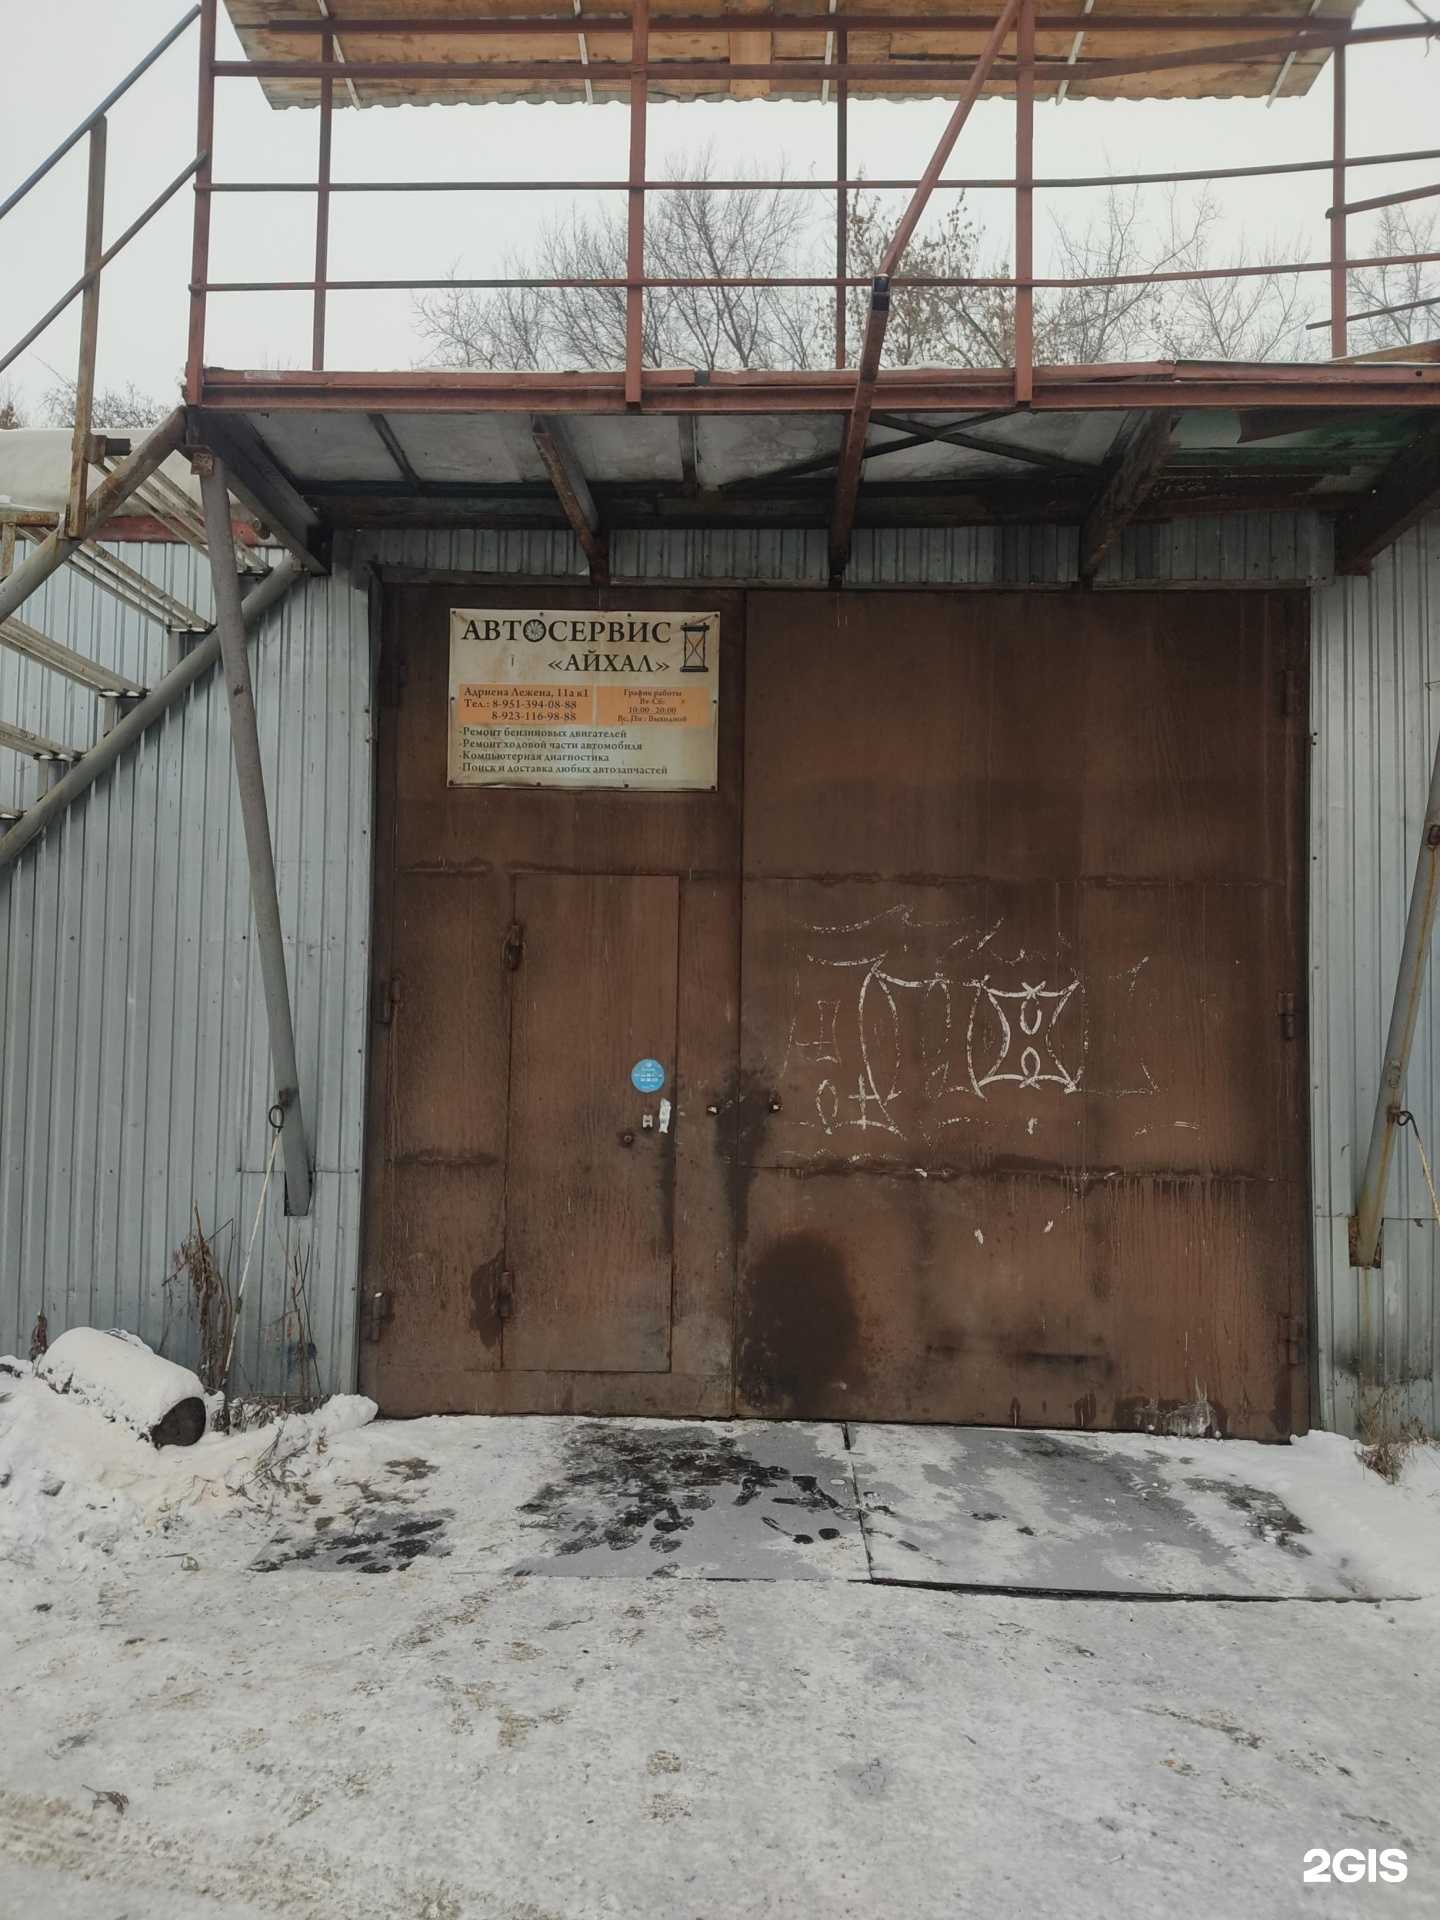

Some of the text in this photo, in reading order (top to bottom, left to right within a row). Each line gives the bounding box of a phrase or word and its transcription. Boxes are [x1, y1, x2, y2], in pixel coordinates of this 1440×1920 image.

[461, 619, 671, 643] АВТОСЕРВИС
[464, 687, 509, 698] Адриена
[492, 700, 577, 709] 8-951-394-08-88
[491, 711, 577, 721] 8-923-116-98-88
[504, 728, 567, 737] бензиновых
[569, 730, 627, 738] двигателей
[503, 740, 546, 750] ходовой
[549, 742, 578, 750] части
[507, 765, 553, 773] доставка
[555, 764, 592, 773] любых
